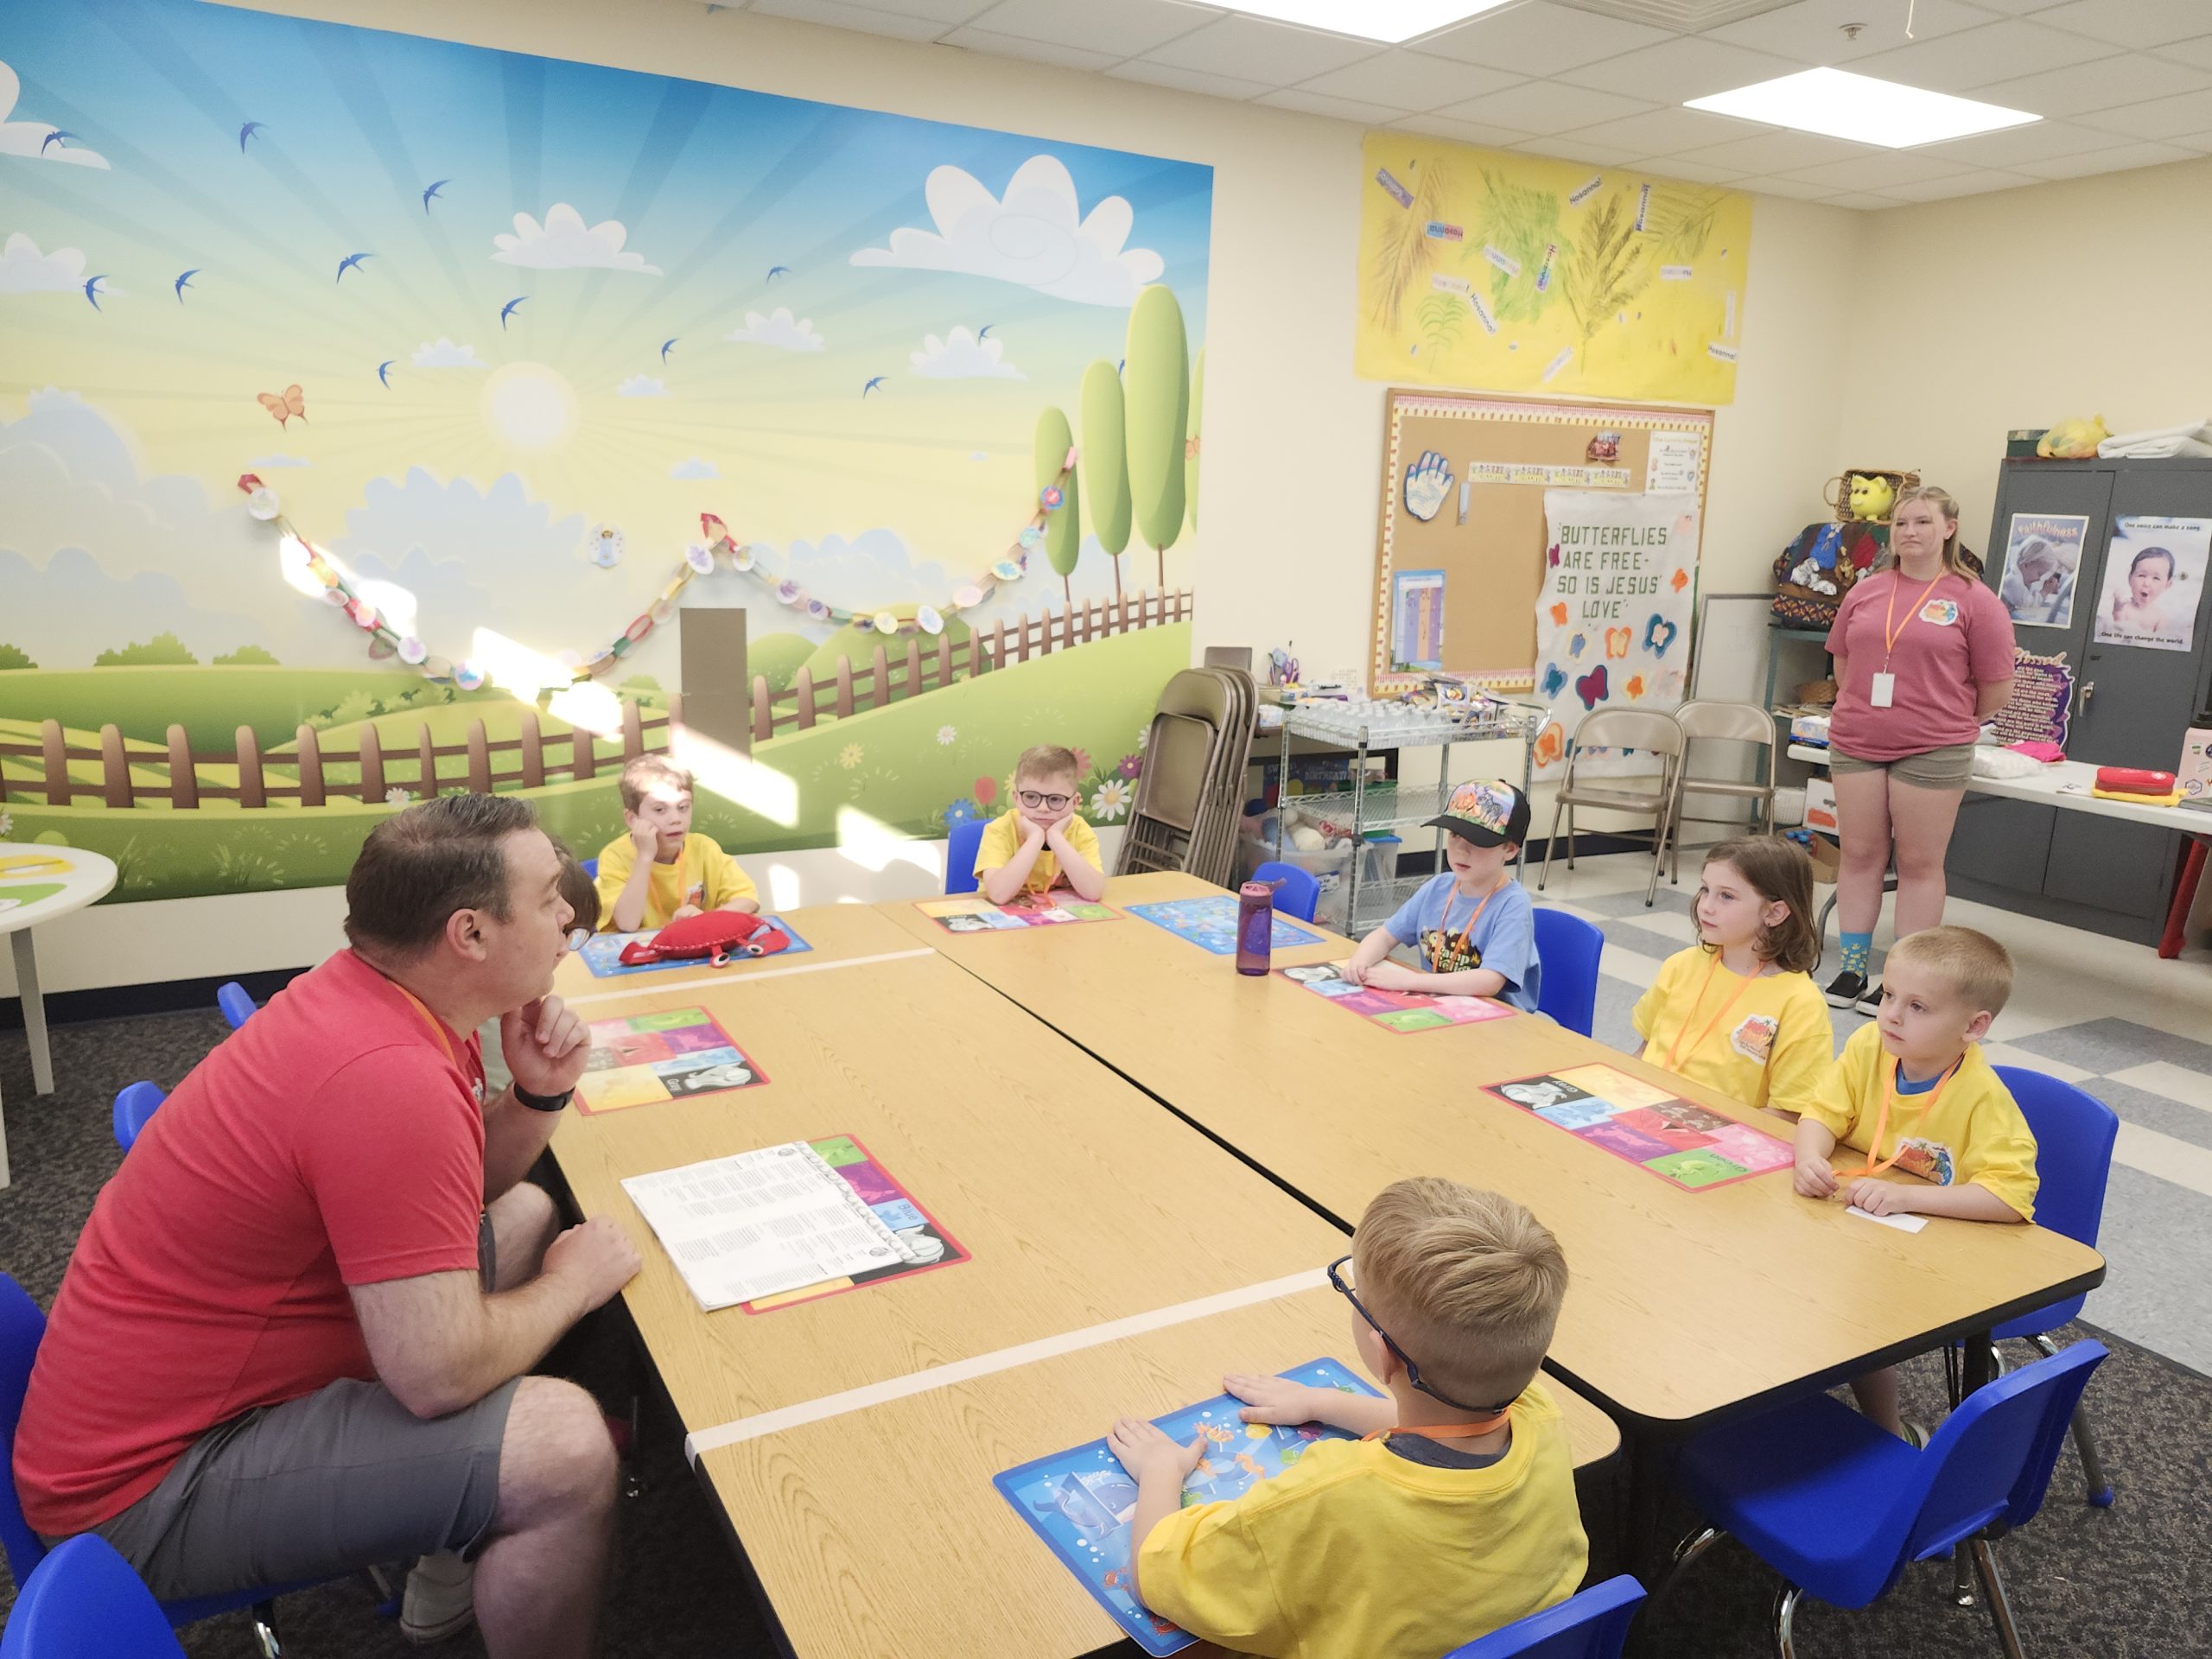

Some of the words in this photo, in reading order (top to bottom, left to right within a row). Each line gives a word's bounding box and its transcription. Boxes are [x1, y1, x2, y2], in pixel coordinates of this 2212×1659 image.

[1562, 551, 1593, 569] ARE
[1557, 575, 1577, 594] SO
[1586, 576, 1599, 594] IS
[898, 1204, 918, 1221] Blue
